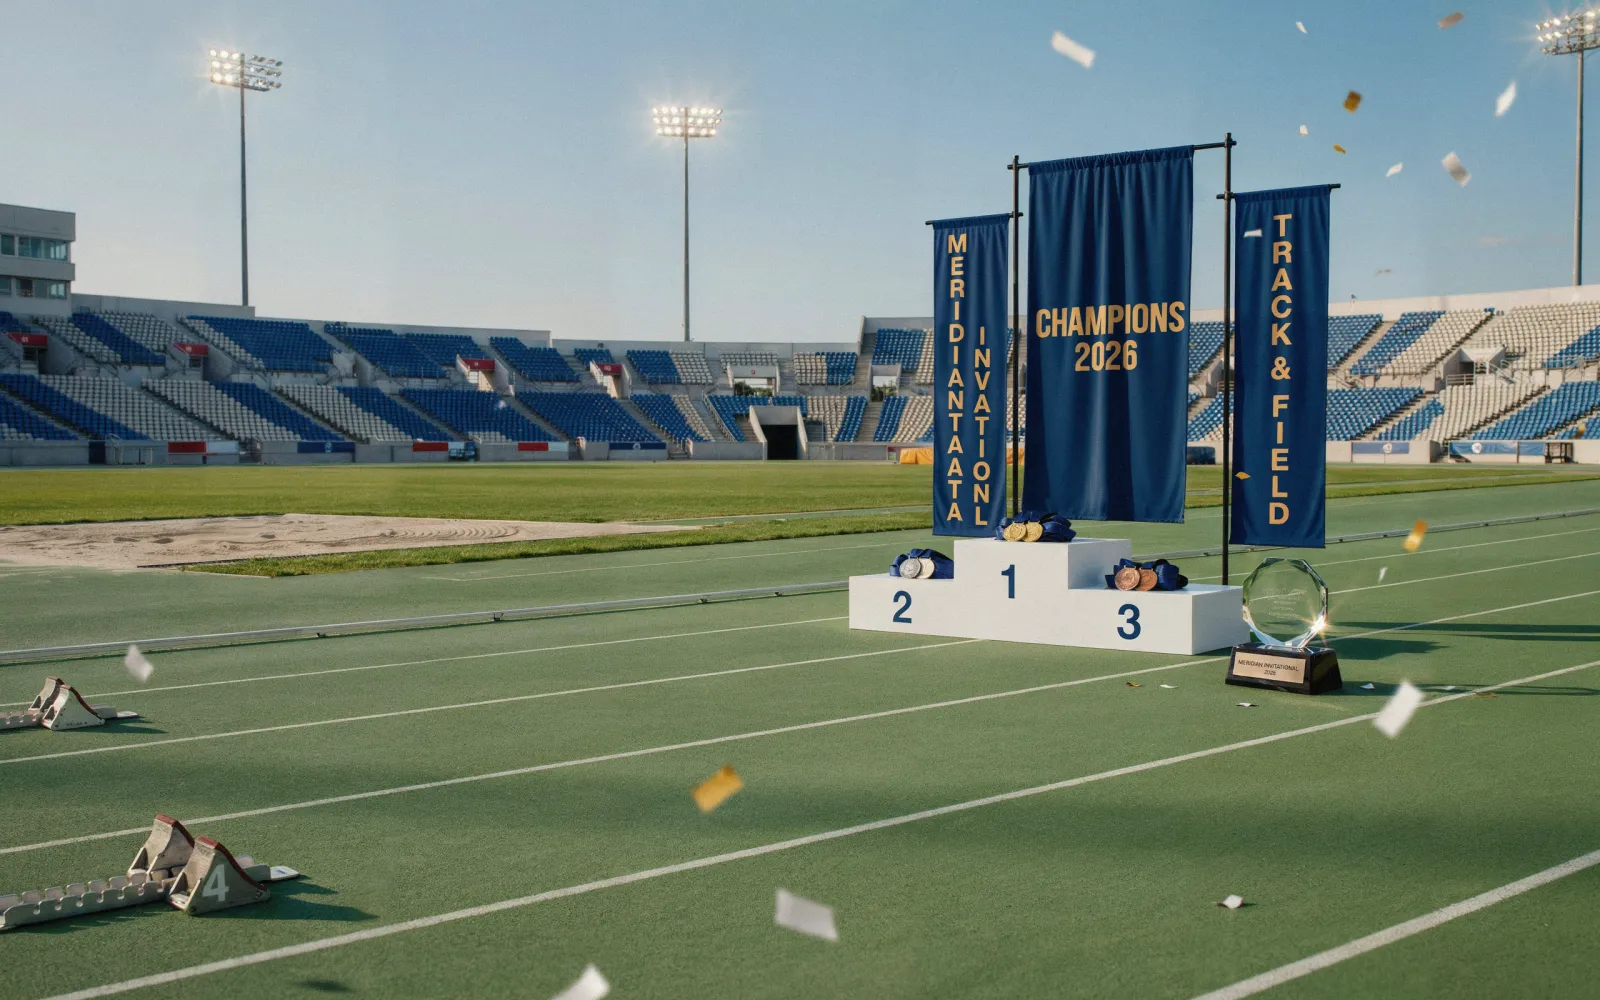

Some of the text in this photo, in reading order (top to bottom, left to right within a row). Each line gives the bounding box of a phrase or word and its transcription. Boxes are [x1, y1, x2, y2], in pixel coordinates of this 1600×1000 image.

[1036, 301, 1185, 339] CHAMPIONS
[1074, 340, 1138, 372] 2026
[1268, 213, 1293, 526] TRACK & FIELD
[973, 326, 991, 526] INVATIONL
[1001, 564, 1015, 598] 1
[893, 590, 912, 624] 2
[1117, 604, 1141, 640] 3
[1237, 659, 1299, 671] MERIDIAN INVITATIONAL
[202, 863, 230, 902] 4
